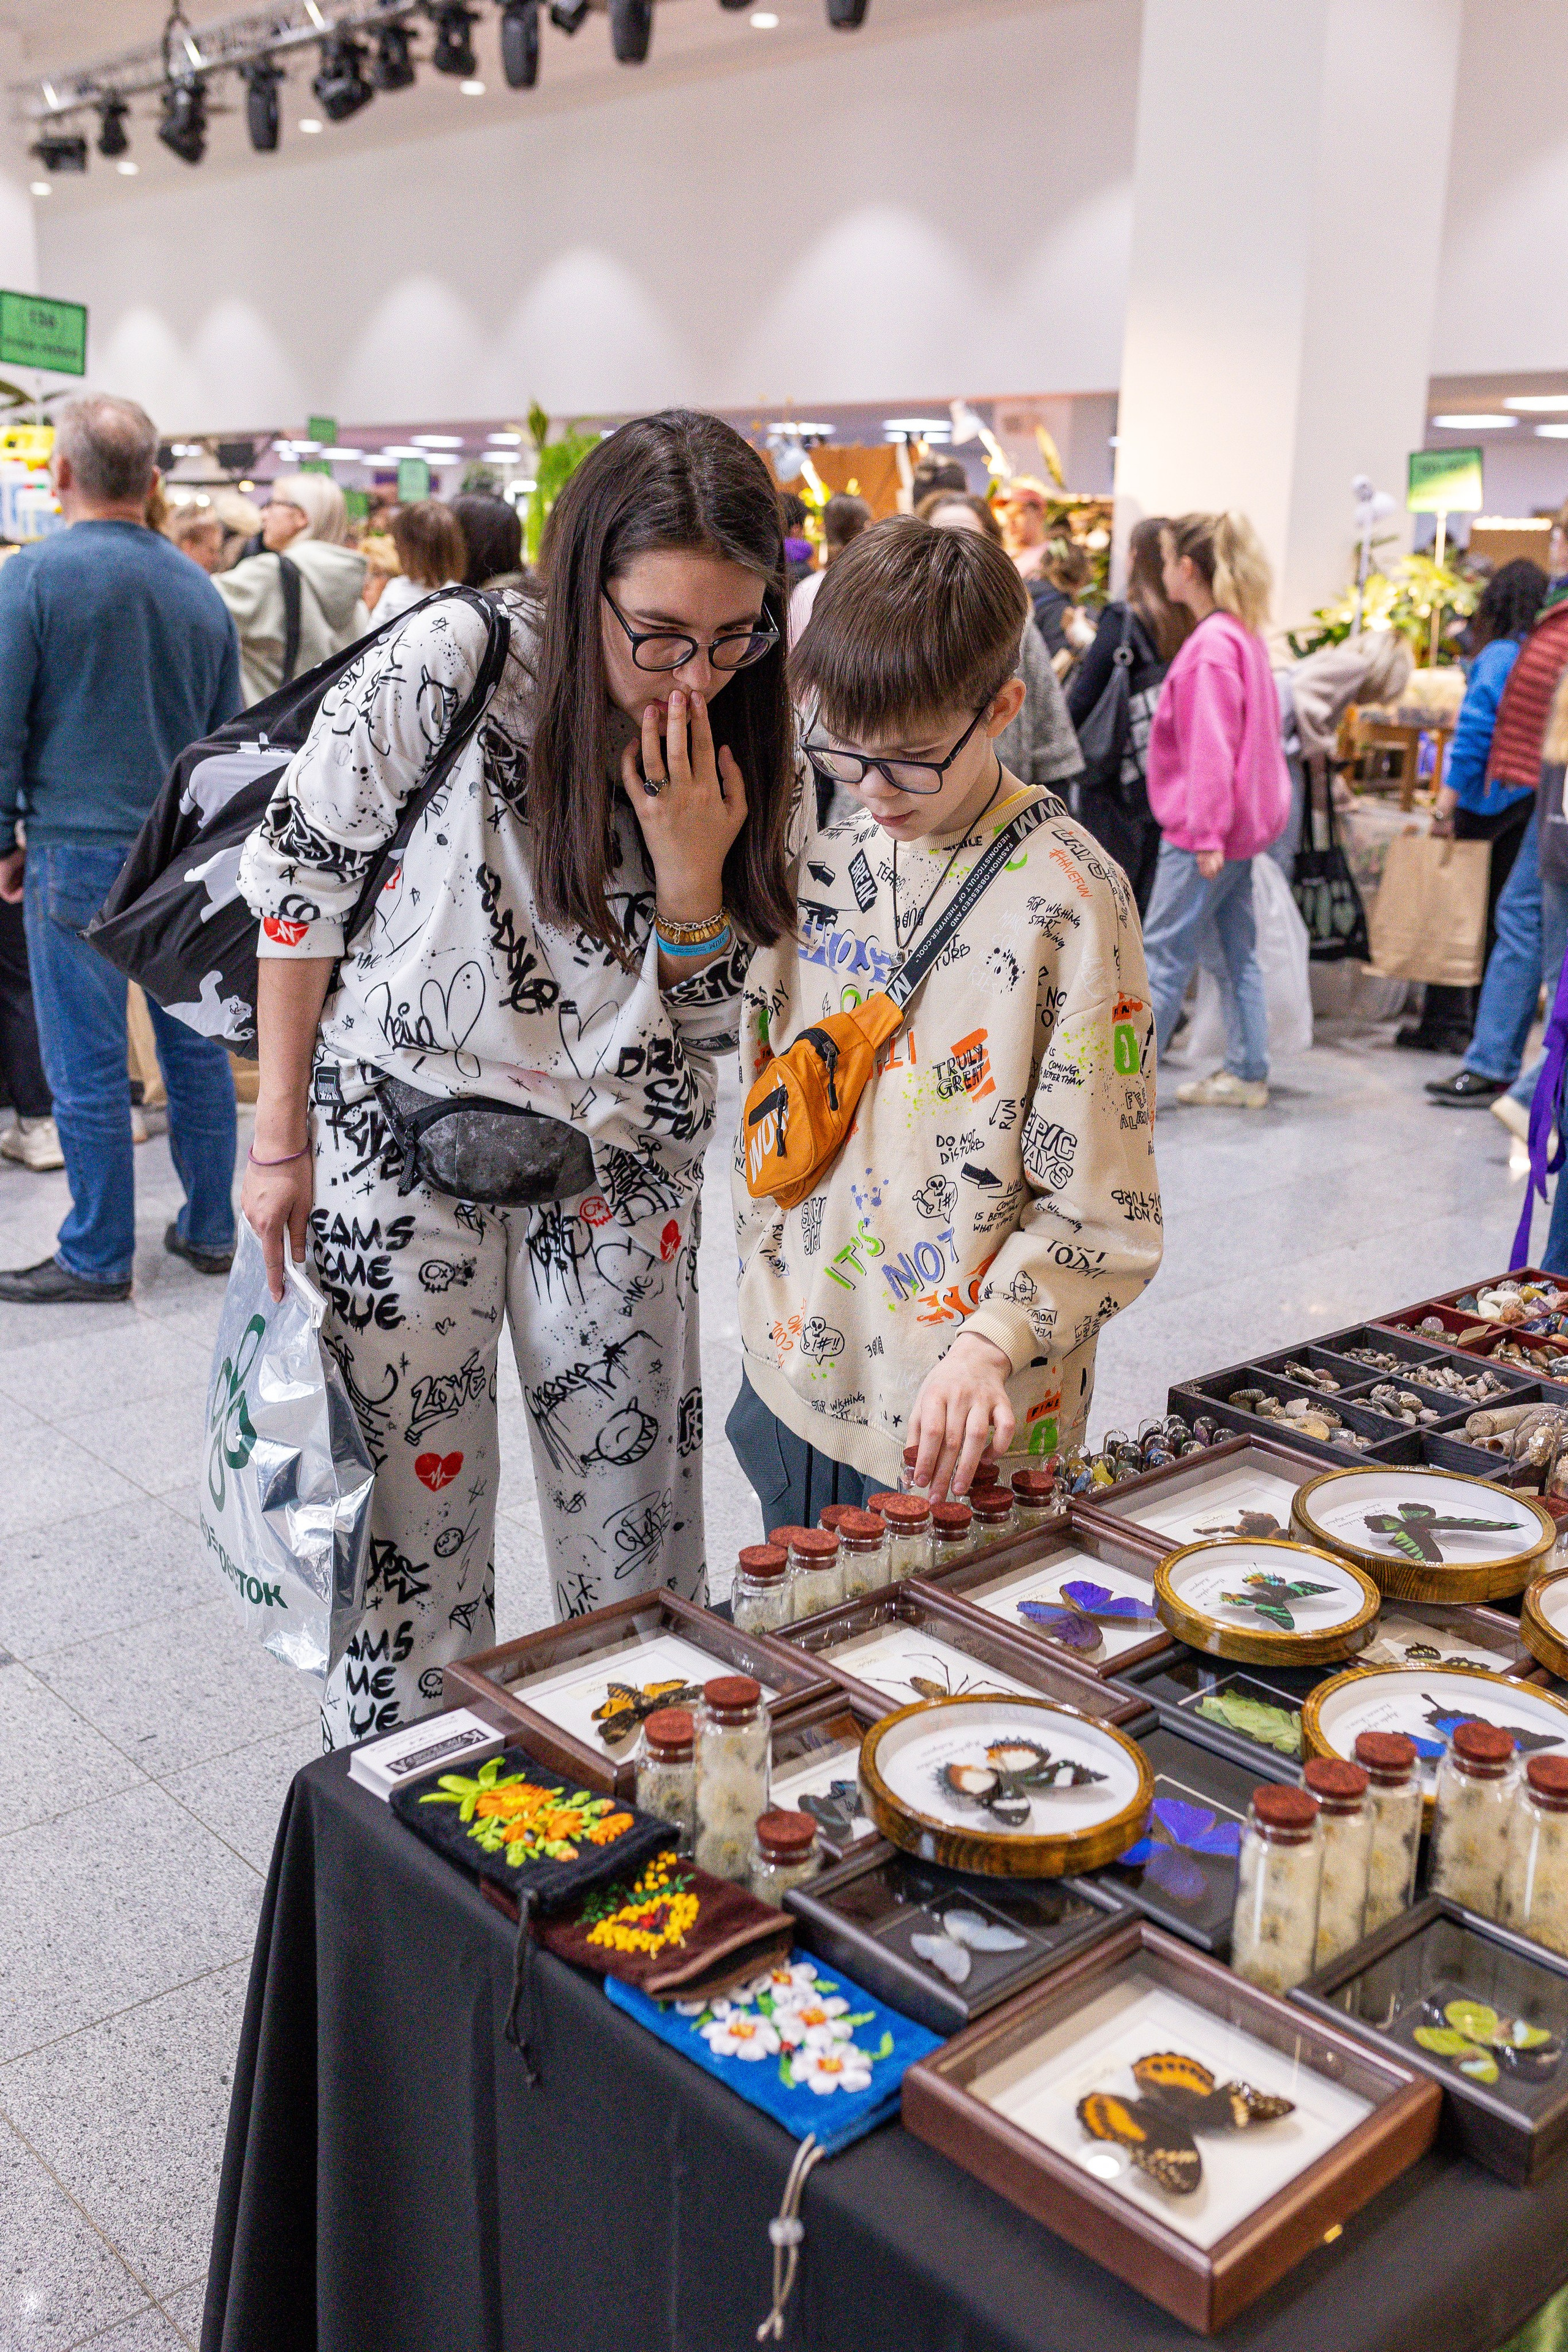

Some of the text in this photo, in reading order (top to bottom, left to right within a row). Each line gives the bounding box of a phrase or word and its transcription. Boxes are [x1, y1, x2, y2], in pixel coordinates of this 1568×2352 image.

[851, 855, 878, 907] BREAK
[876, 861, 906, 892] TEAM
[962, 843, 1013, 911] FASHION-OBSESSED
[1049, 847, 1093, 899] #HAVEFUN
[957, 892, 967, 905] OF
[950, 911, 963, 927] AND
[1026, 895, 1081, 929] STOP WISHING
[1028, 914, 1061, 932] START
[1042, 930, 1066, 951] DOING
[932, 1043, 984, 1080] TRULY
[1049, 1060, 1080, 1077] COMING
[937, 1062, 985, 1099] GREAT
[1043, 1071, 1085, 1087] BETTER THAN
[999, 1099, 1017, 1130] RUN
[936, 1129, 976, 1148] DO NOT
[940, 1138, 985, 1164] DISTURB
[974, 1211, 984, 1220] IS
[1124, 1207, 1150, 1223] NOT
[973, 1223, 993, 1233] WHAT
[313, 1240, 394, 1291] COME
[823, 1220, 886, 1291] IT'S
[881, 1226, 959, 1301] NOT
[830, 1392, 865, 1413] WISHING
[1031, 1398, 1060, 1418] FINE
